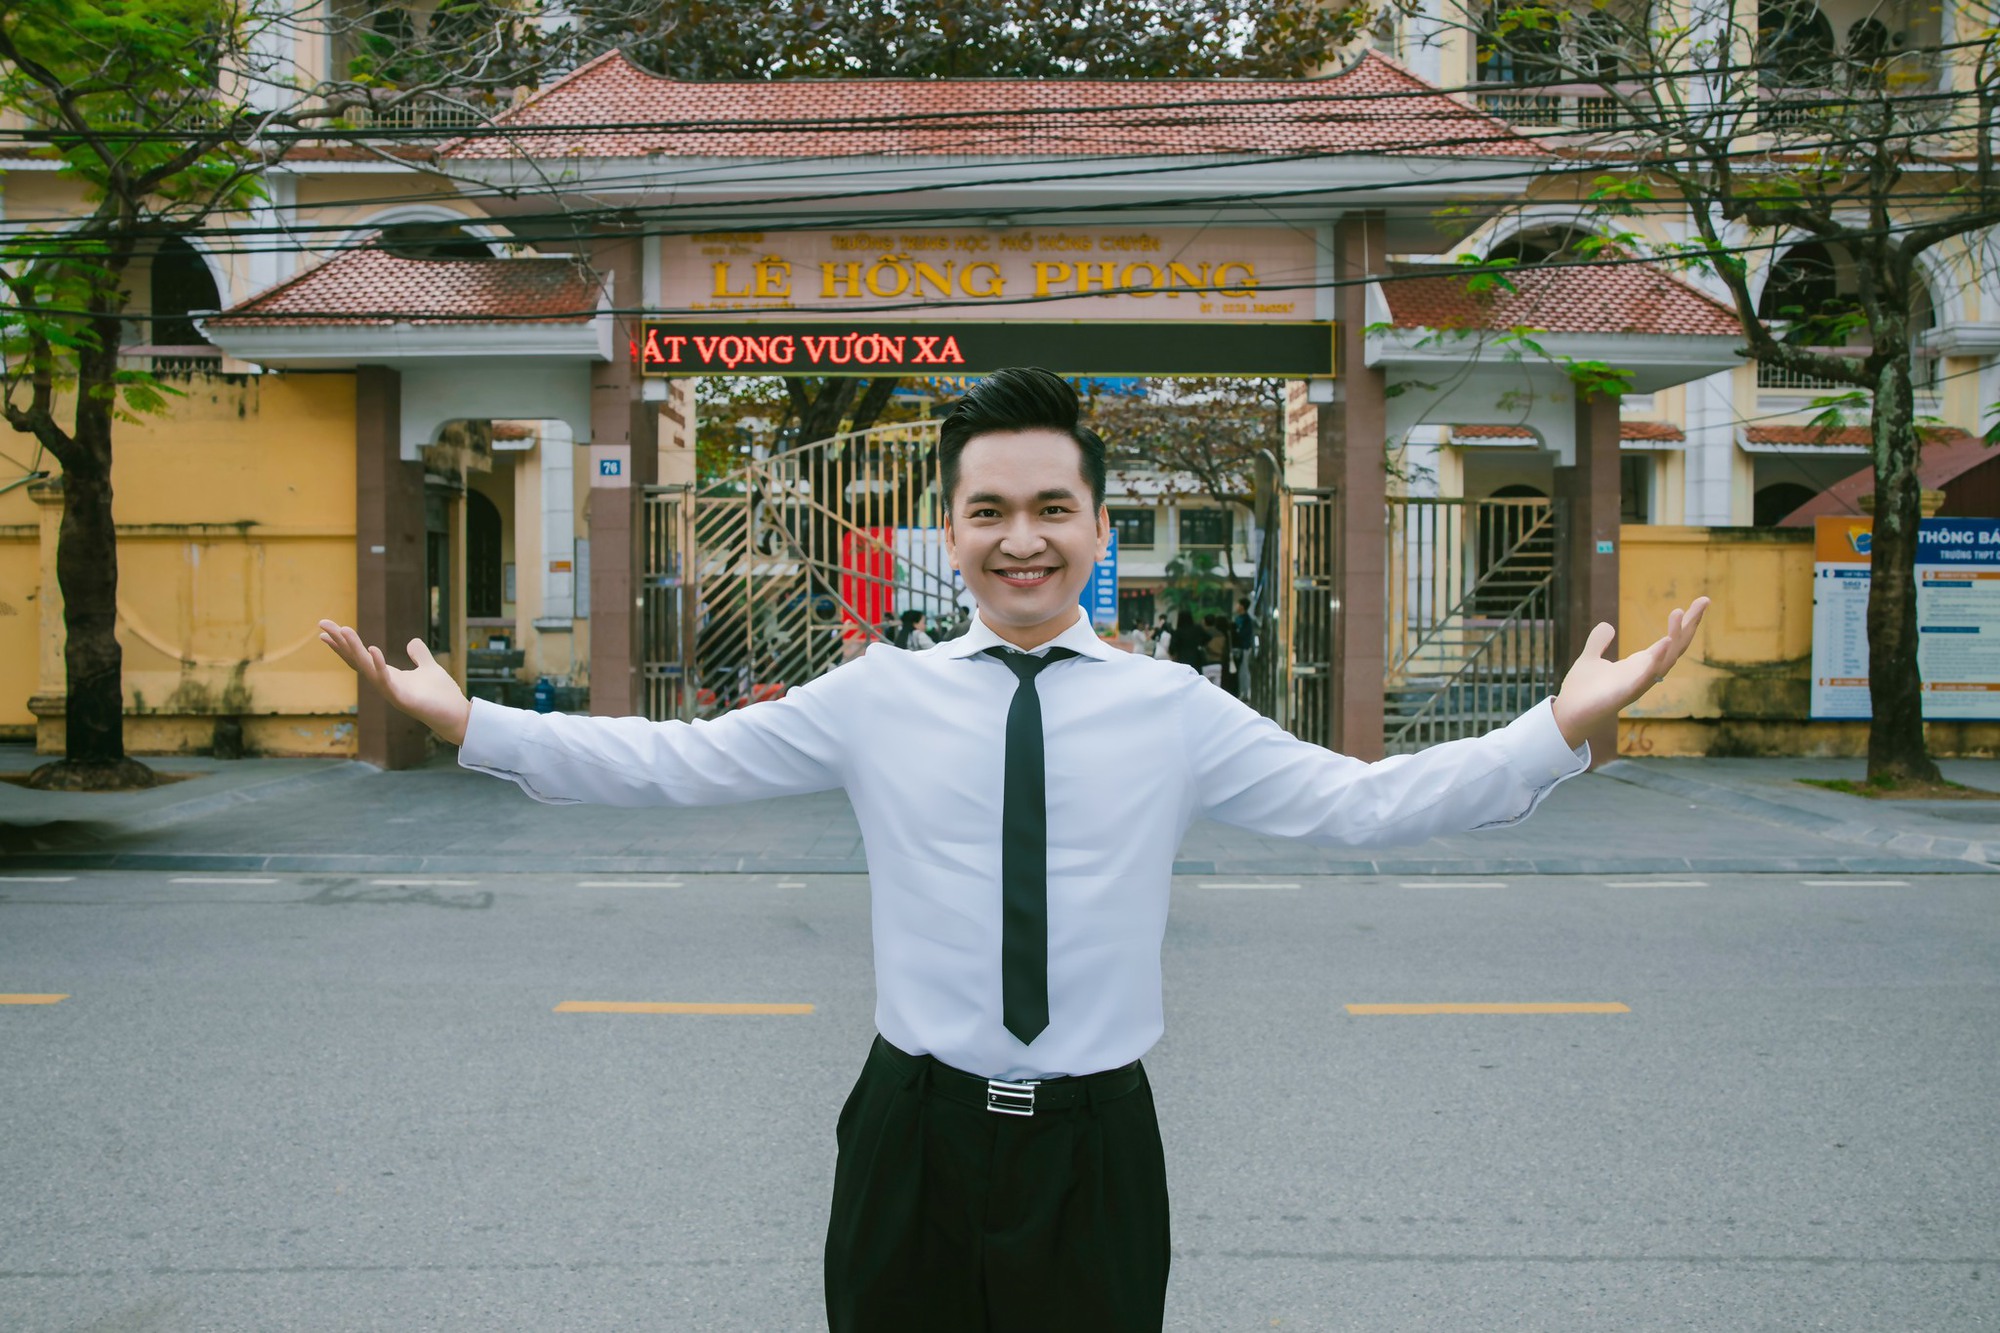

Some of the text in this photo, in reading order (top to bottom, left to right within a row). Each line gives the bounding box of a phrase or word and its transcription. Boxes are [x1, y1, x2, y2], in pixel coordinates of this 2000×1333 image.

[902, 235, 949, 250] TRUNG
[955, 235, 990, 253] HỌC
[1002, 232, 1034, 251] PHỔ
[1038, 233, 1093, 250] THÔNG
[1100, 233, 1161, 251] CHUYÊN
[711, 252, 1260, 298] LÊ HỒNG PHONG
[692, 335, 796, 369] VỌNG
[801, 332, 906, 364] VƯƠN
[911, 335, 965, 363] XA
[603, 462, 618, 474] 76
[1918, 527, 1975, 544] THÔNG
[1974, 550, 1994, 559] THPT
